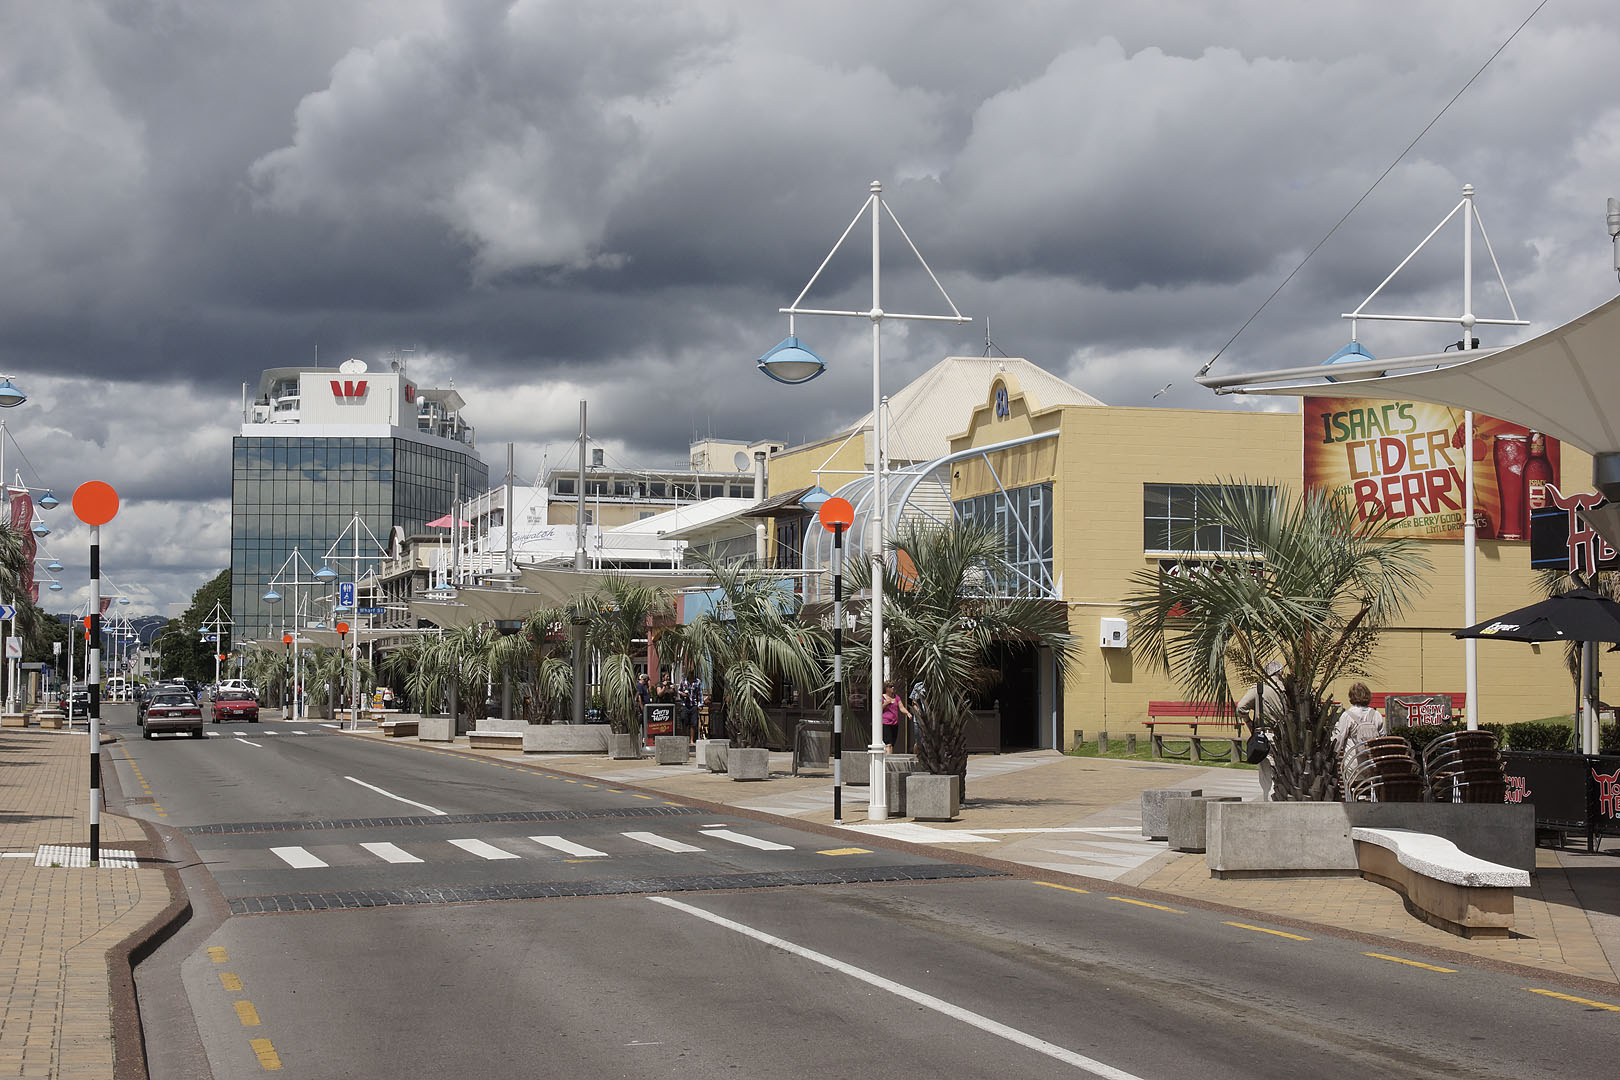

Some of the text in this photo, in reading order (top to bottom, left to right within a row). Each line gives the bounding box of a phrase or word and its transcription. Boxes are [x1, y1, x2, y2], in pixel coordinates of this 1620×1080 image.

[995, 388, 1009, 417] 81
[1320, 402, 1417, 444] ISAAC'S
[1345, 429, 1455, 480] CIDER
[1333, 467, 1466, 522] with BERRY
[1413, 513, 1439, 527] BERRY
[1440, 512, 1462, 524] GOOD
[1426, 525, 1446, 534] LITTLE
[1394, 697, 1450, 728] Horny
[1423, 714, 1443, 726] Bull
